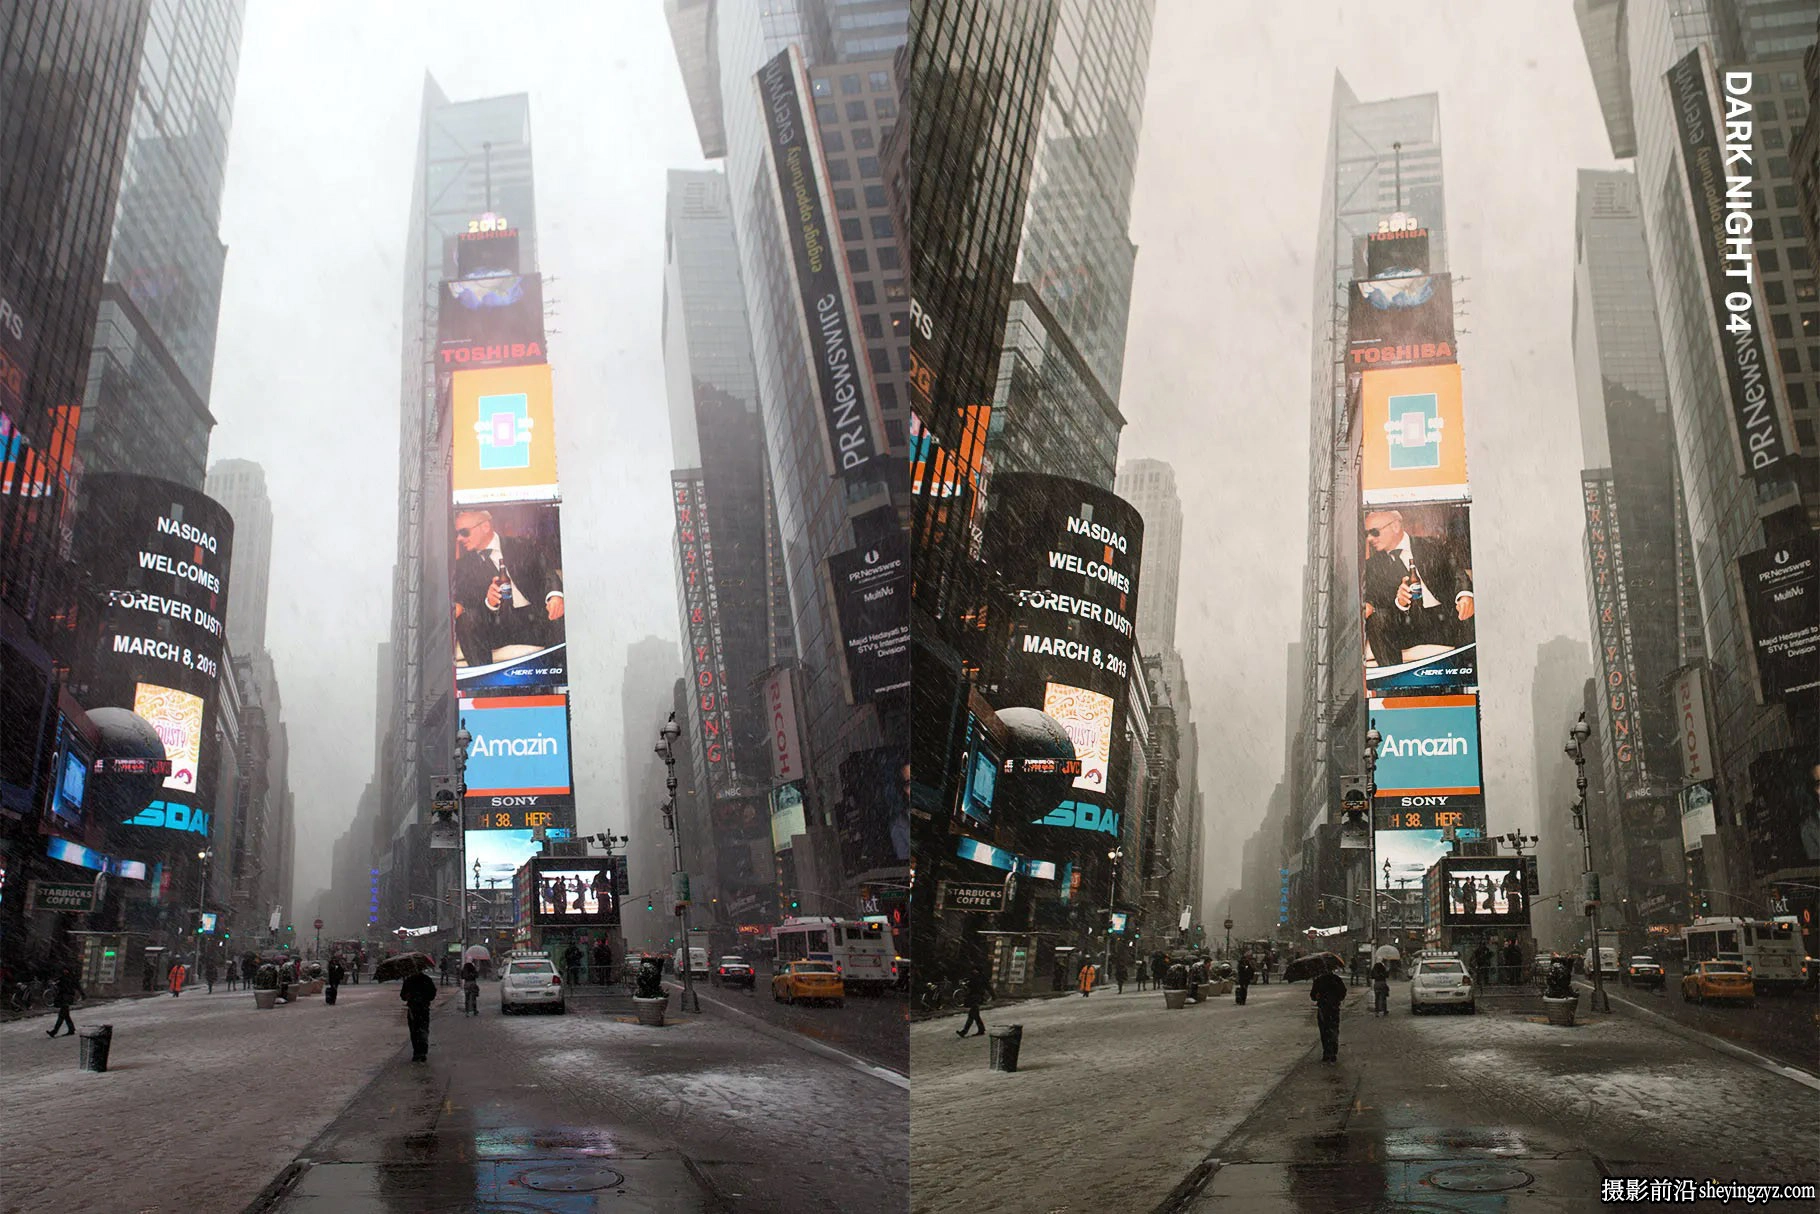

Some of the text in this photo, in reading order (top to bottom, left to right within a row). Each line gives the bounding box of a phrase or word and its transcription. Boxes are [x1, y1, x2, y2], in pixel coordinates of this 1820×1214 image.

[1696, 146, 1724, 222] opportunity
[786, 146, 824, 272] engage opportunity
[460, 229, 517, 241] TOSHIBA
[1370, 229, 1427, 241] TOSHIBA
[441, 342, 542, 364] TOSHIBA
[1351, 342, 1452, 364] TOSHIBA
[156, 516, 218, 554] NASDAQ
[1066, 516, 1128, 554] NASDAQ
[138, 551, 220, 594] WELCOMES
[1048, 551, 1130, 594] WELCOMES
[108, 590, 192, 622] FOREVER
[692, 608, 703, 623] &
[1018, 590, 1102, 622] FOREVER
[1602, 608, 1613, 623] &
[113, 634, 217, 678] MARCH 8, 2013
[878, 646, 906, 658] Division
[1023, 634, 1127, 678] MARCH 8, 2013
[1788, 646, 1816, 658] Division
[511, 668, 534, 676] HERE
[1421, 668, 1444, 676] HERE
[696, 647, 721, 762] YOUNG
[1606, 647, 1631, 762] YOUNG
[770, 682, 790, 774] RICOH
[1680, 682, 1700, 774] RICOH
[470, 732, 558, 757] Amazin
[1380, 732, 1468, 757] Amazin
[491, 796, 538, 807] SONY
[725, 788, 742, 797] NBC
[1401, 796, 1448, 807] SONY
[1635, 788, 1652, 797] NBC
[38, 887, 92, 898] STARBUCKS
[46, 896, 81, 906] COFFEE
[948, 887, 1002, 898] STARBUCKS
[956, 896, 991, 906] COFFEE
